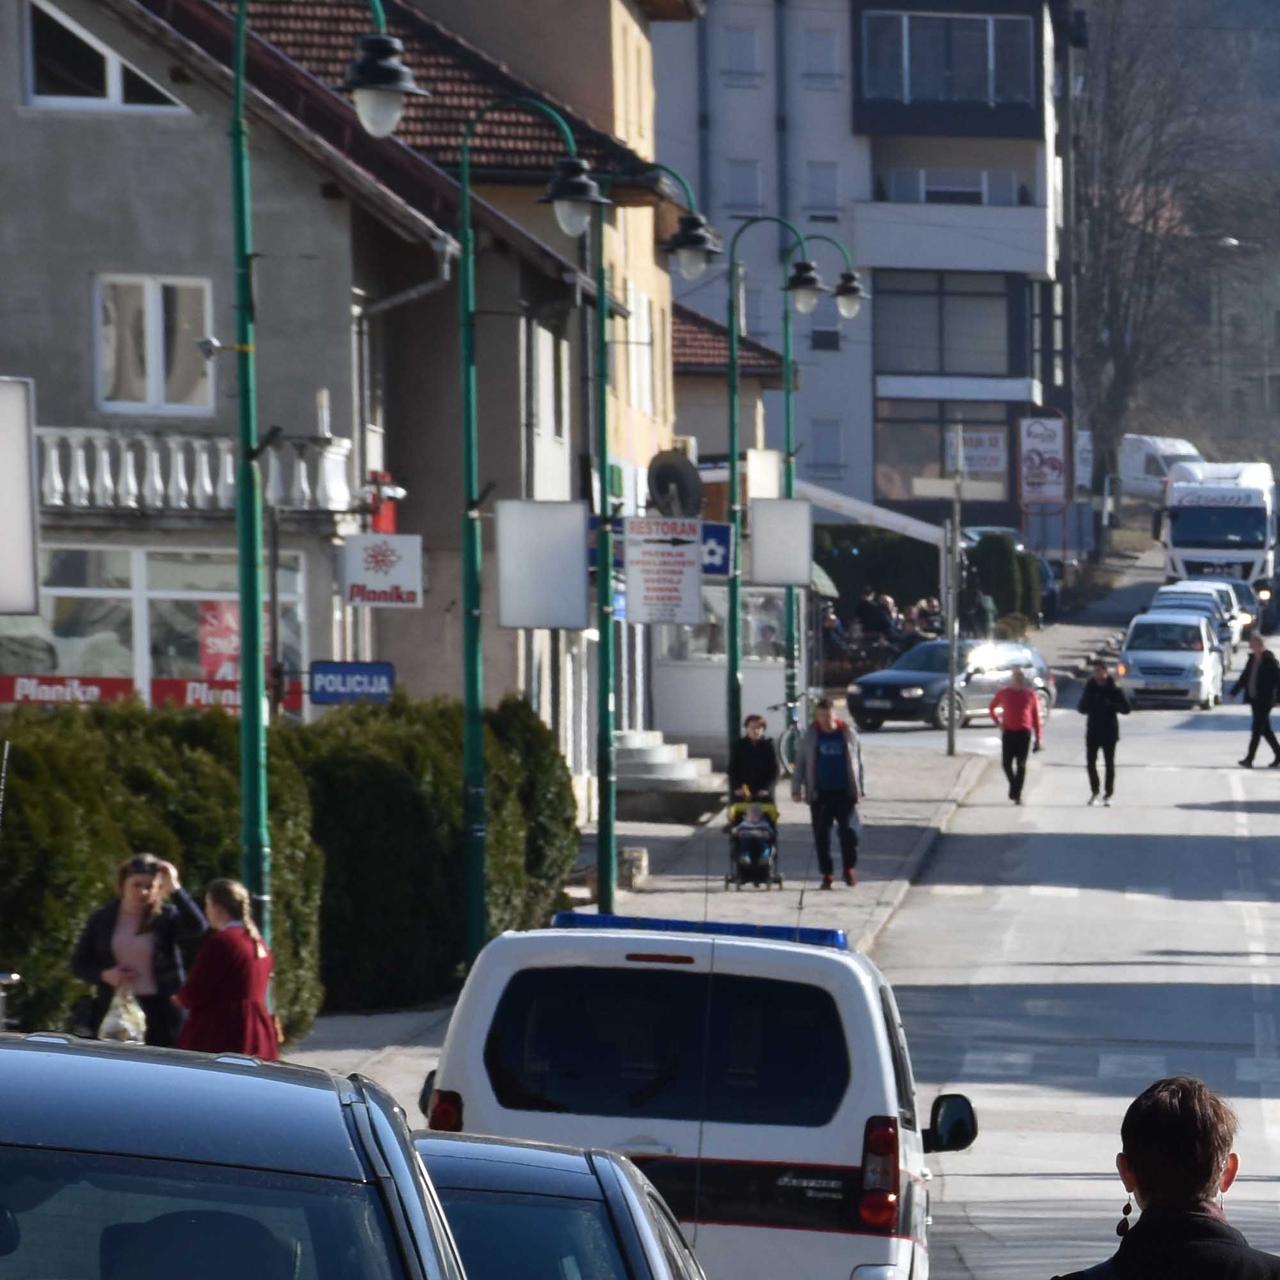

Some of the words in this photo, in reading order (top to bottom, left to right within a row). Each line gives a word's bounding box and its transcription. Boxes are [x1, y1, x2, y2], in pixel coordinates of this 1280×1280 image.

[629, 521, 698, 535] RESTORAN
[351, 584, 417, 602] Planika
[14, 678, 101, 702] Planika
[314, 673, 390, 693] POLICIJA
